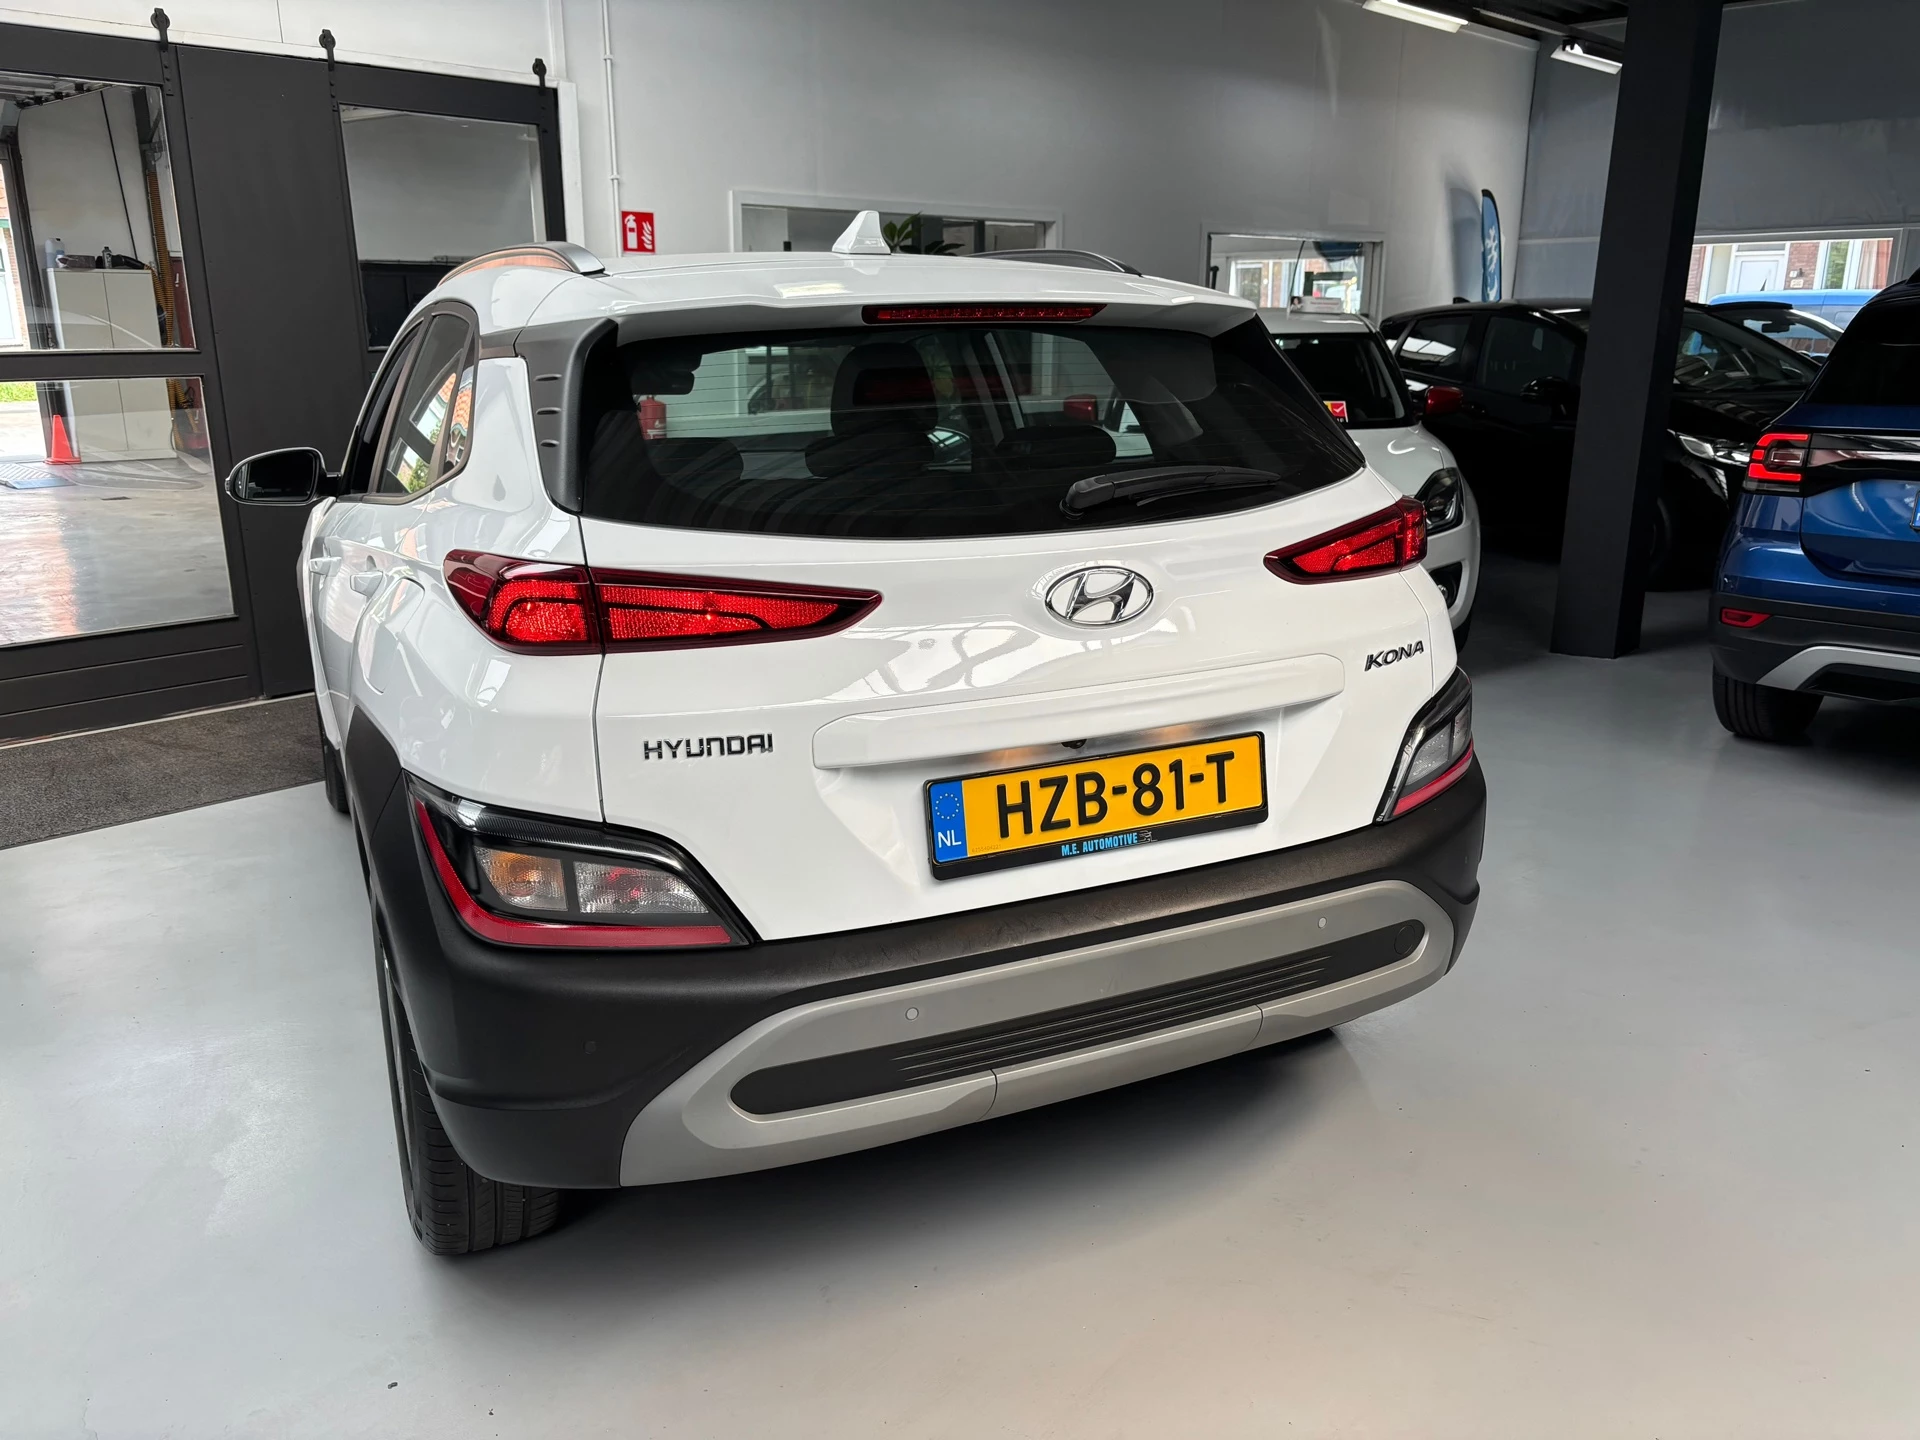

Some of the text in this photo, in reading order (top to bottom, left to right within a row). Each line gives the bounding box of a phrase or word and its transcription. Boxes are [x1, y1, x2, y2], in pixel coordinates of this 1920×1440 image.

[1364, 640, 1424, 671] KONA
[643, 732, 774, 760] HYUNDAI
[997, 751, 1235, 839] HZB-81-T
[937, 829, 962, 848] NL
[1061, 832, 1138, 857] M.E. AUTOMOTIVE
